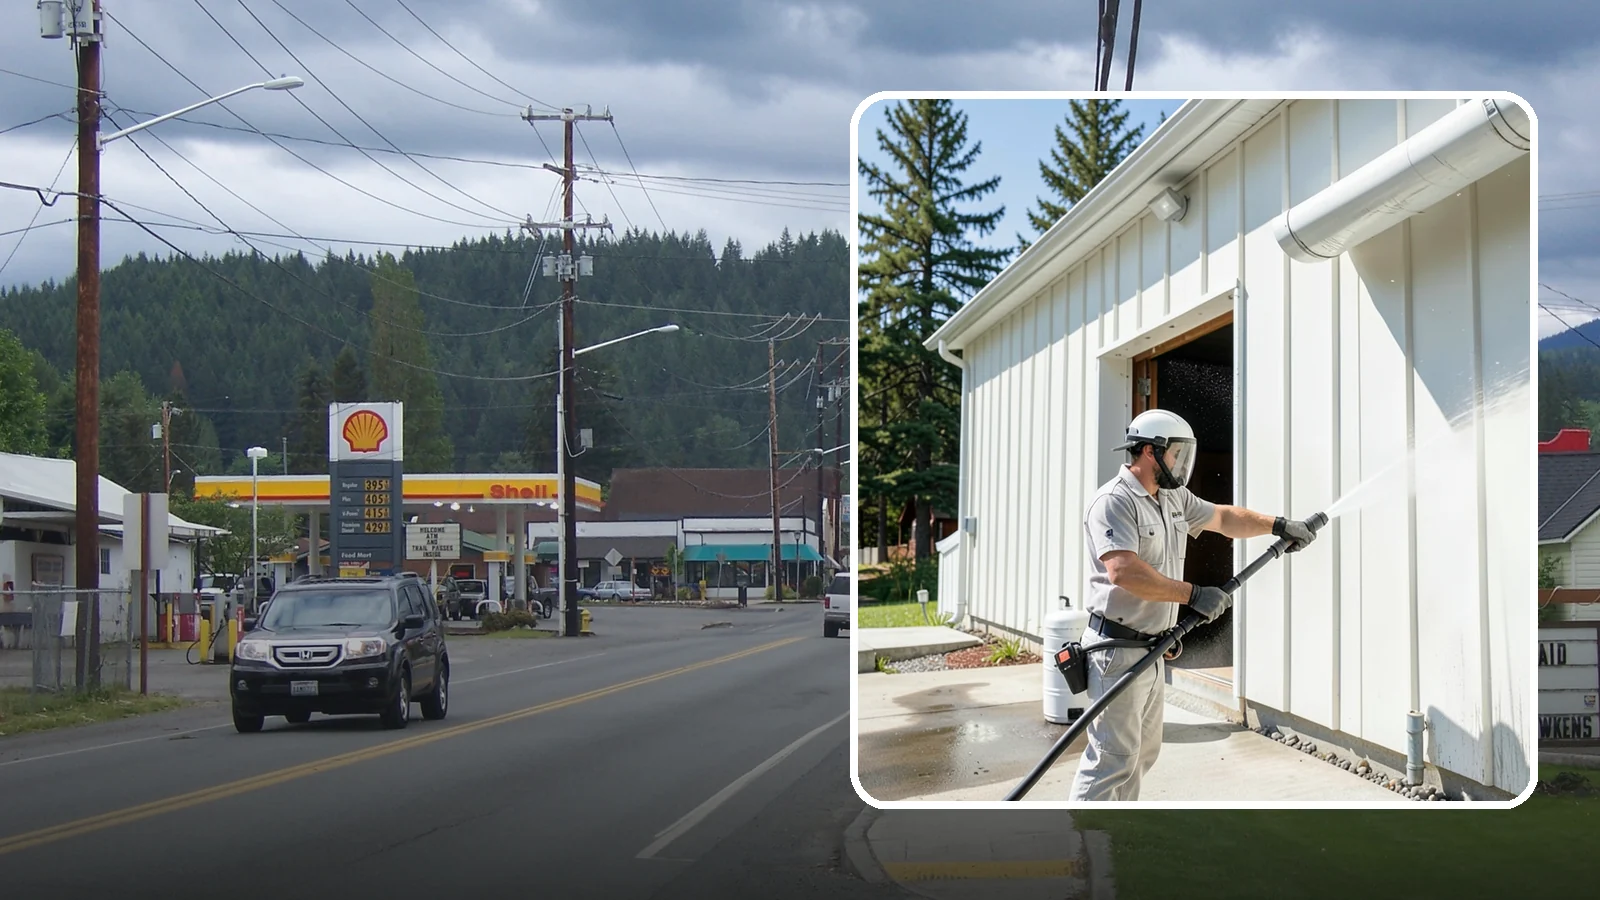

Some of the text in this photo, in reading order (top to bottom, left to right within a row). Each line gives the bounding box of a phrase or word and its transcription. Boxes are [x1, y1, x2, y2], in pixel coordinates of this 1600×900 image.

[365, 480, 383, 490] 395
[490, 484, 547, 499] Shell
[365, 494, 383, 504] 405
[365, 508, 383, 518] 415
[365, 522, 383, 532] 429
